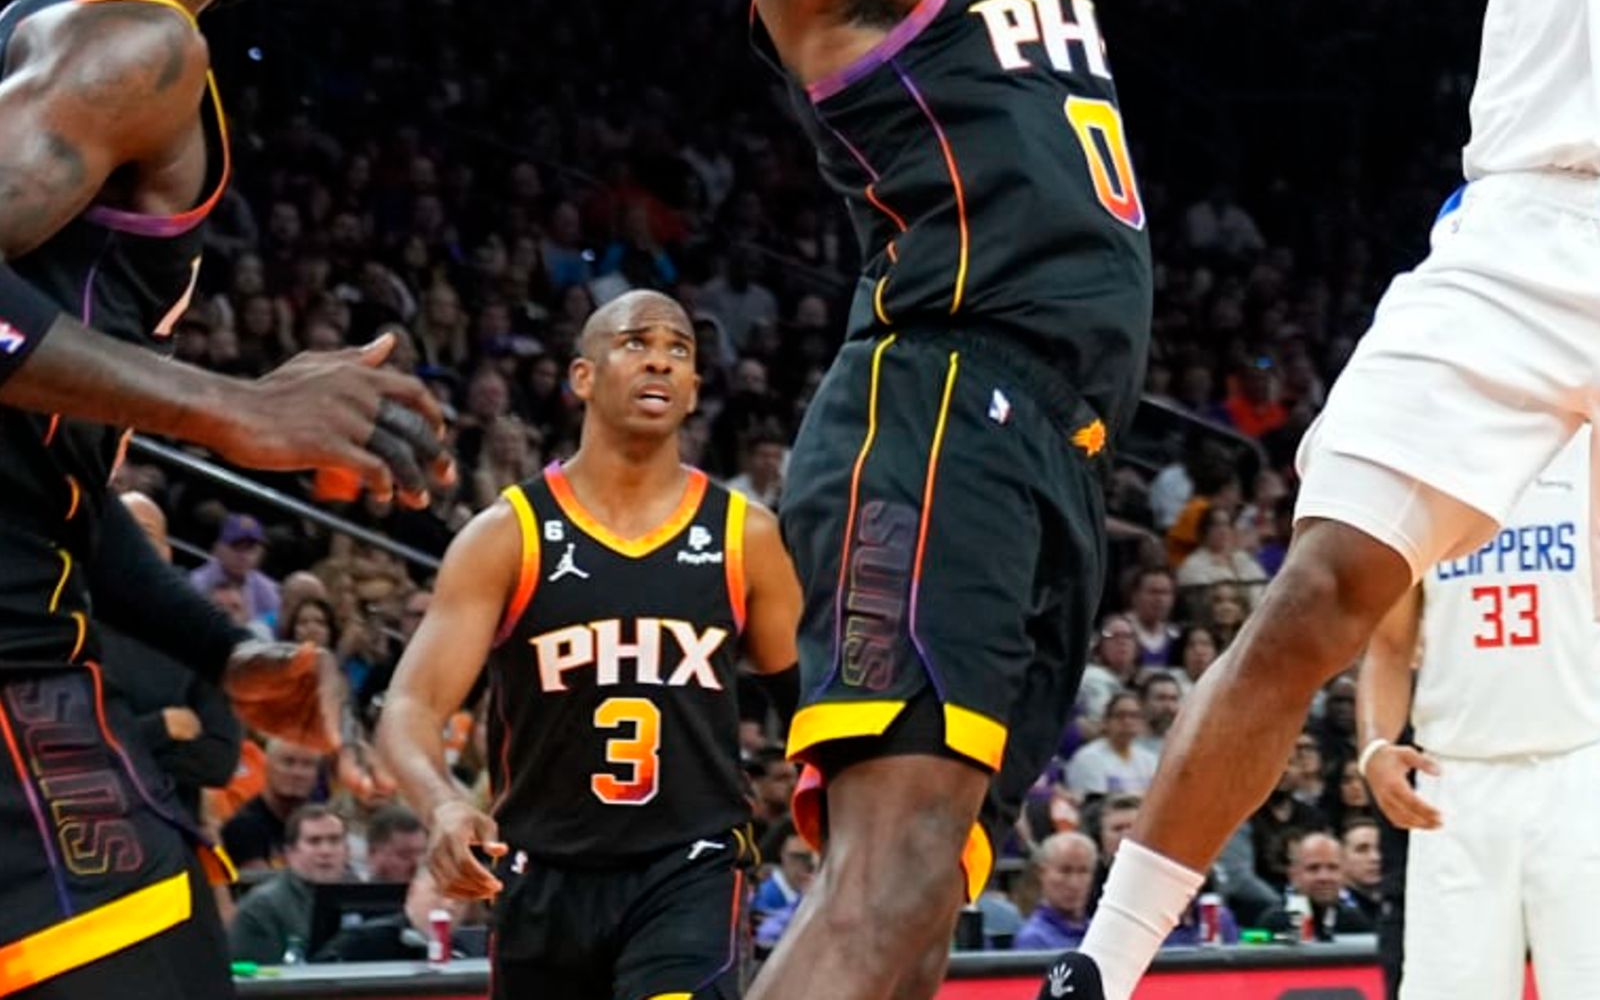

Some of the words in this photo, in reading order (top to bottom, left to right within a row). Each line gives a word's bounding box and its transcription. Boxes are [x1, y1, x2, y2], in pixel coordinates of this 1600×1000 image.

[1063, 93, 1147, 232] 0
[544, 520, 565, 541] 6
[1470, 583, 1540, 648] 33
[528, 616, 729, 693] PHX
[591, 697, 661, 805] 3
